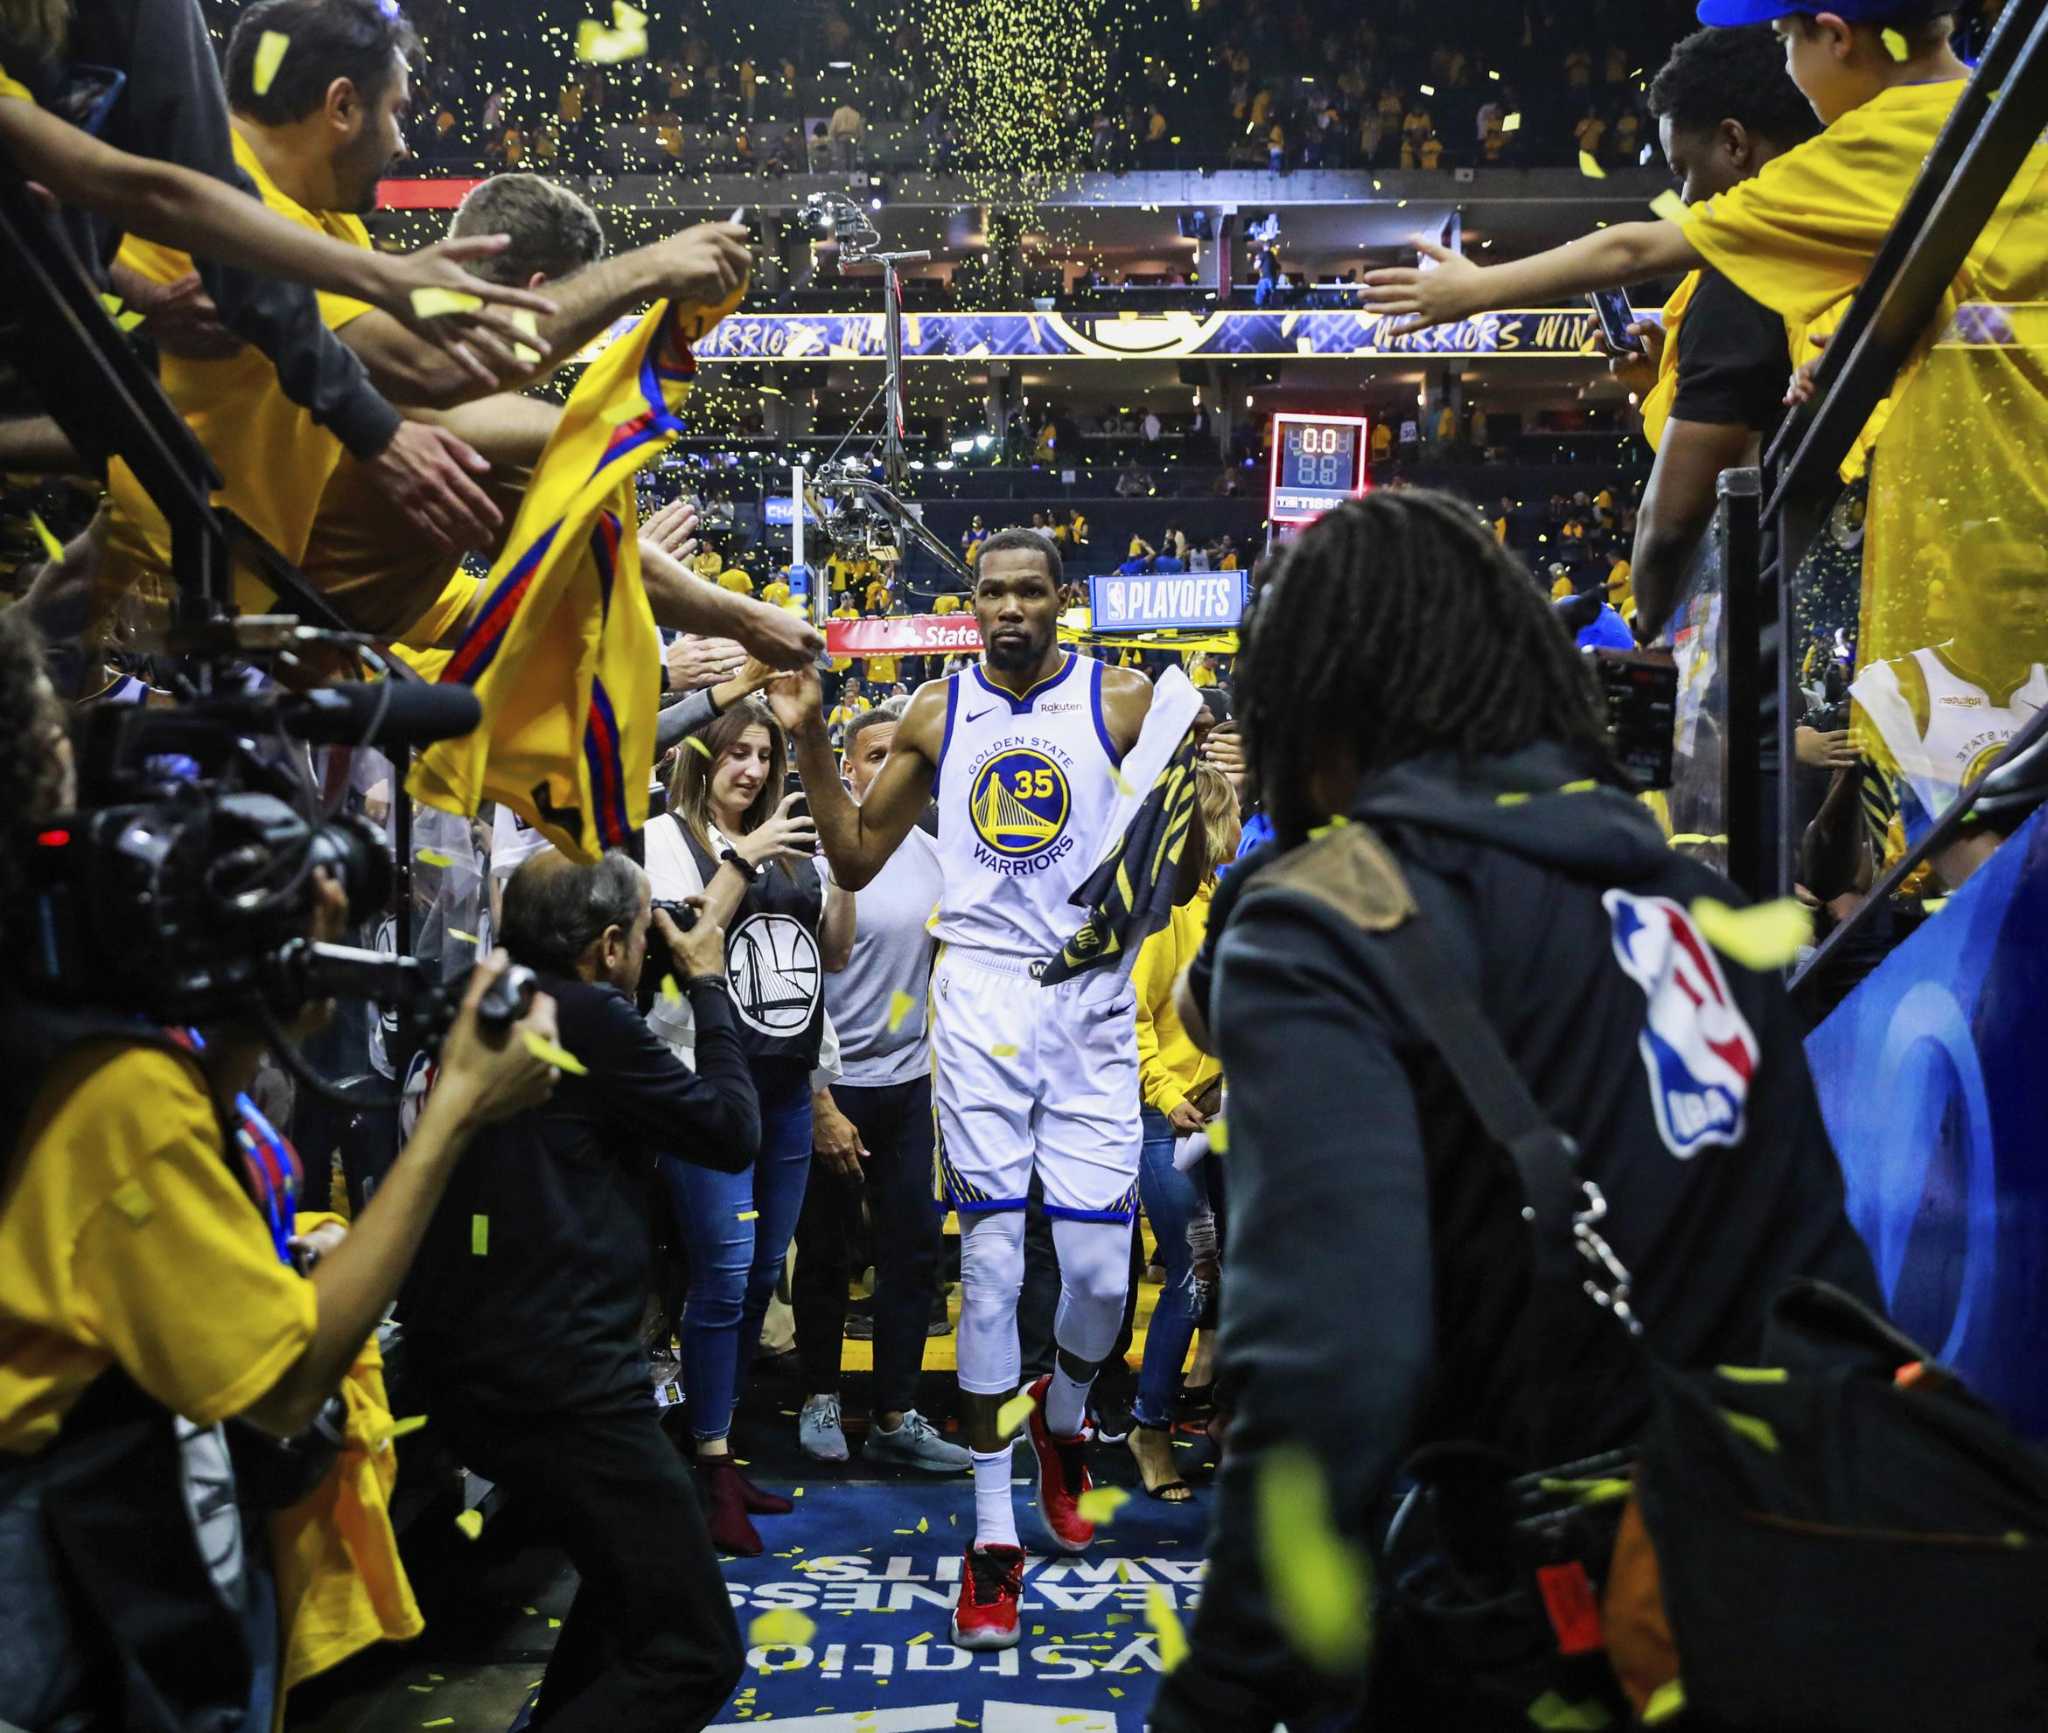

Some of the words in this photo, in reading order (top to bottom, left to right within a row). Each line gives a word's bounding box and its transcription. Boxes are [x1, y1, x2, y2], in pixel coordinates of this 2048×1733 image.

[691, 321, 828, 356] ARRIOS
[1534, 314, 1589, 348] WIN
[1128, 578, 1230, 619] PLAYOFFS
[925, 625, 977, 646] State
[1040, 702, 1082, 715] Rakuten
[968, 736, 1025, 775] GOLDEN
[1031, 736, 1074, 769] STATE
[1014, 769, 1054, 799] 35
[973, 834, 1074, 876] WARRIORS
